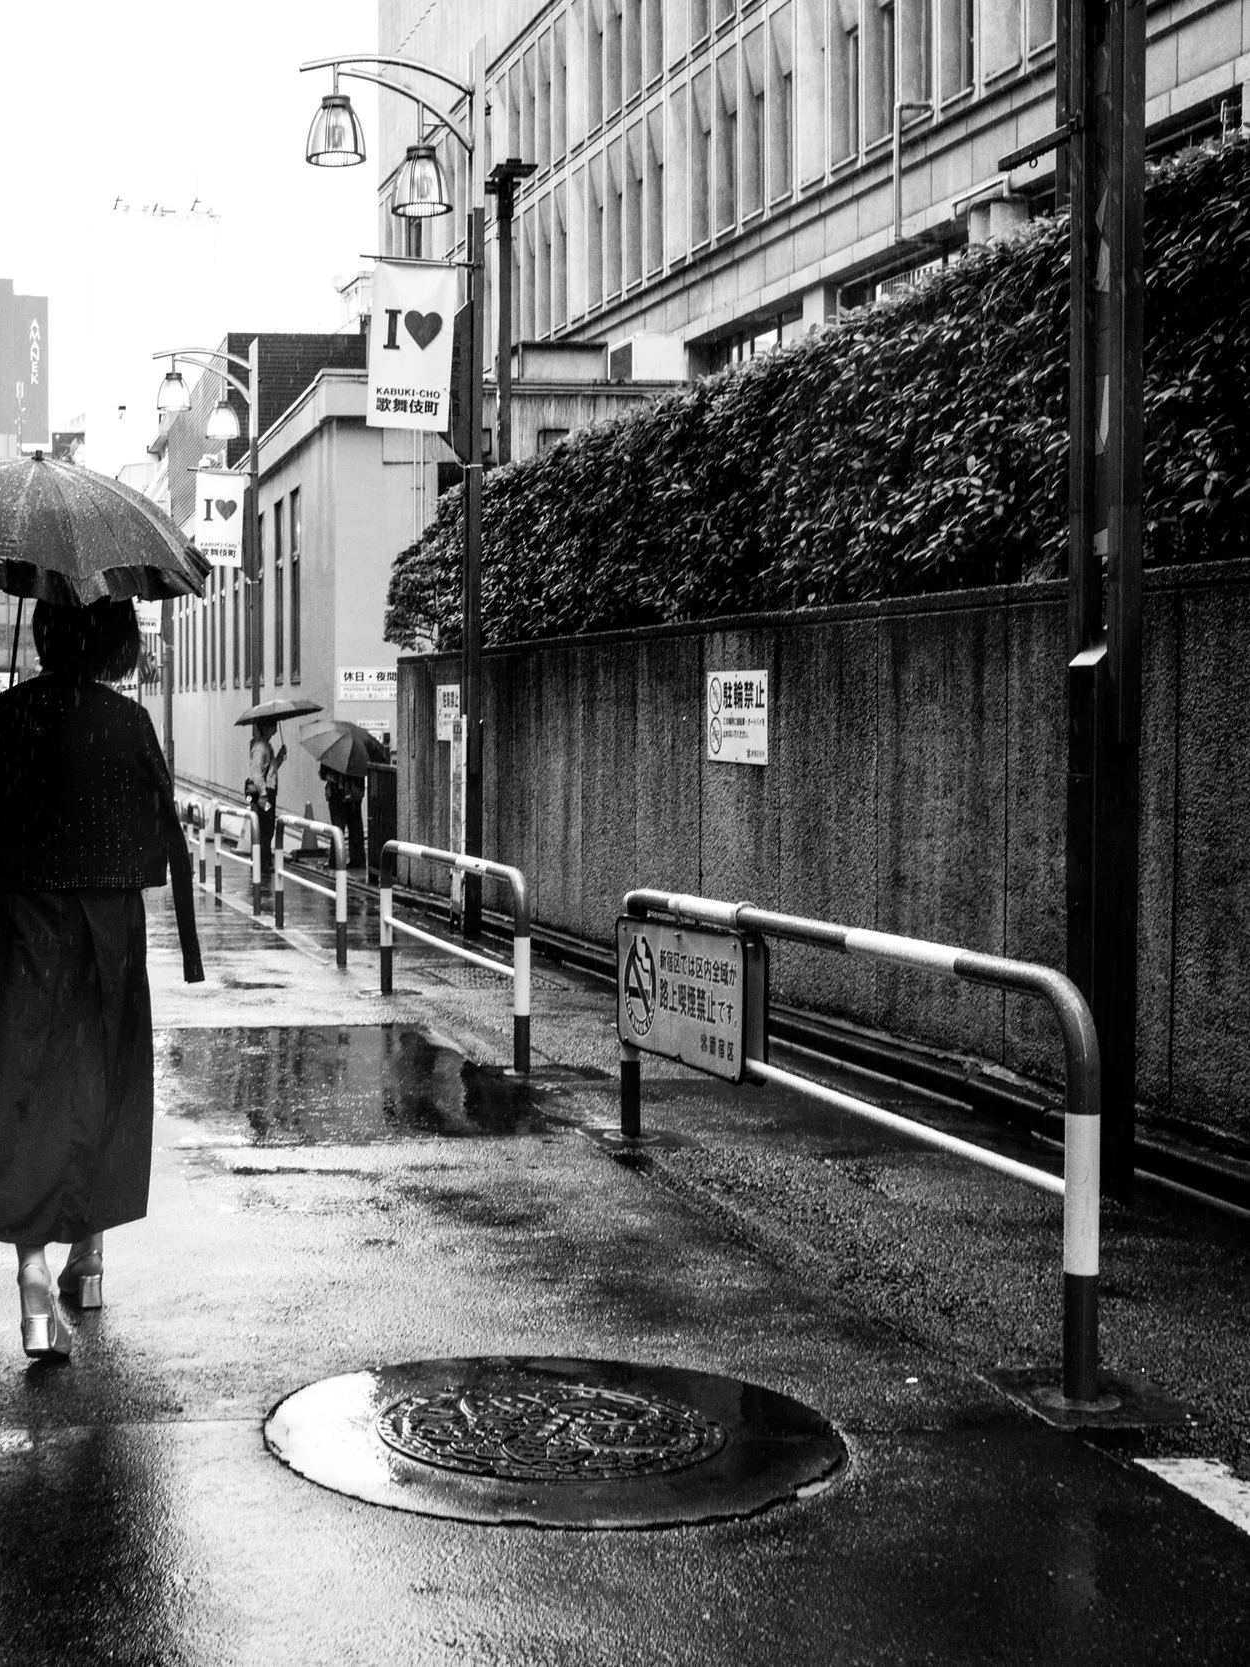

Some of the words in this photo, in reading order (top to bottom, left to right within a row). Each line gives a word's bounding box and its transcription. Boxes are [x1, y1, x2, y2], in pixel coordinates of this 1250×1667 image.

[383, 309, 402, 350] I
[29, 317, 41, 385] AMANEK
[376, 387, 441, 399] KABUKI-CHO
[376, 397, 439, 416] 歌舞伎町
[204, 499, 214, 521] I
[723, 680, 765, 709] 駐輪禁止
[659, 949, 738, 987] 新宿区では区内全域が
[659, 978, 738, 1029] 路上喫煙禁止です。
